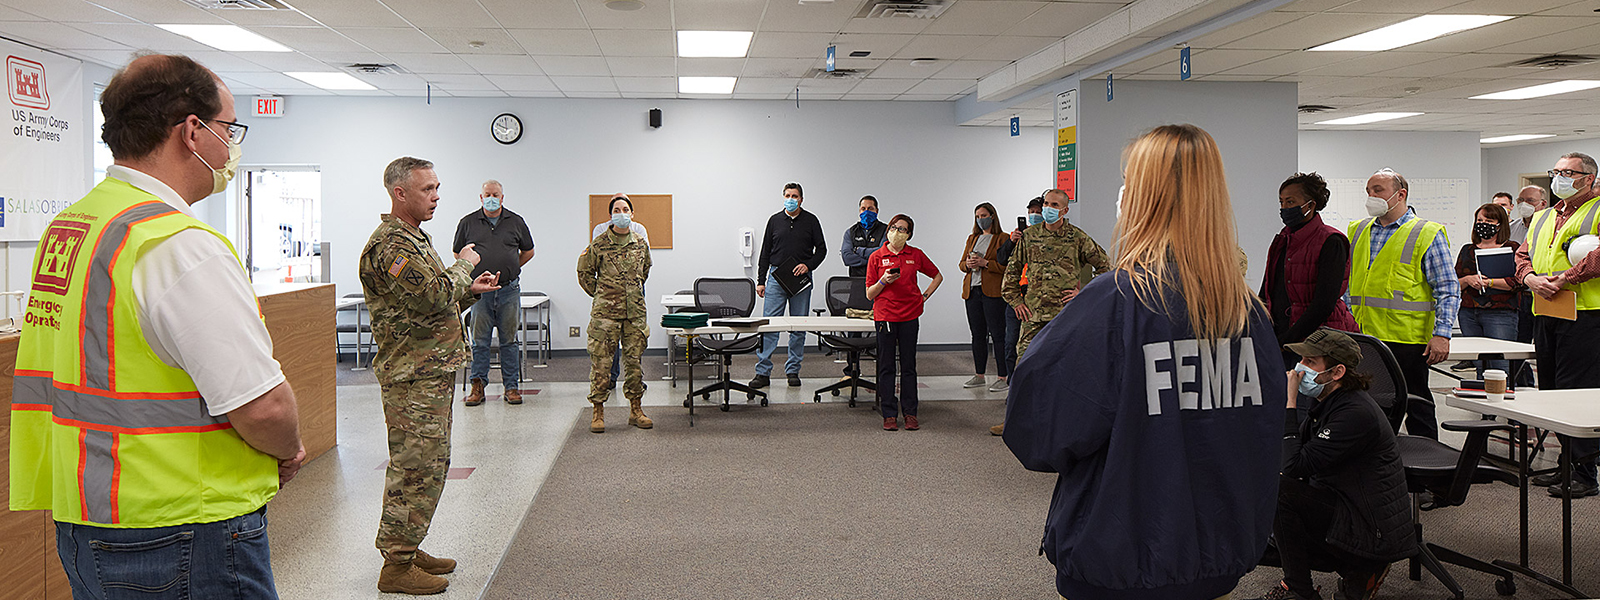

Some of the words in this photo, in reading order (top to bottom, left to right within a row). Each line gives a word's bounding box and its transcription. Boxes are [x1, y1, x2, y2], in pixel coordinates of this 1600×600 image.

[827, 53, 834, 66] 4
[1182, 56, 1188, 74] 6
[258, 99, 277, 114] EXIT
[12, 109, 26, 122] US
[29, 112, 48, 128] Army
[49, 116, 69, 131] Corps
[13, 125, 23, 136] of
[26, 126, 60, 141] Engineers
[1143, 337, 1262, 415] FEMA
